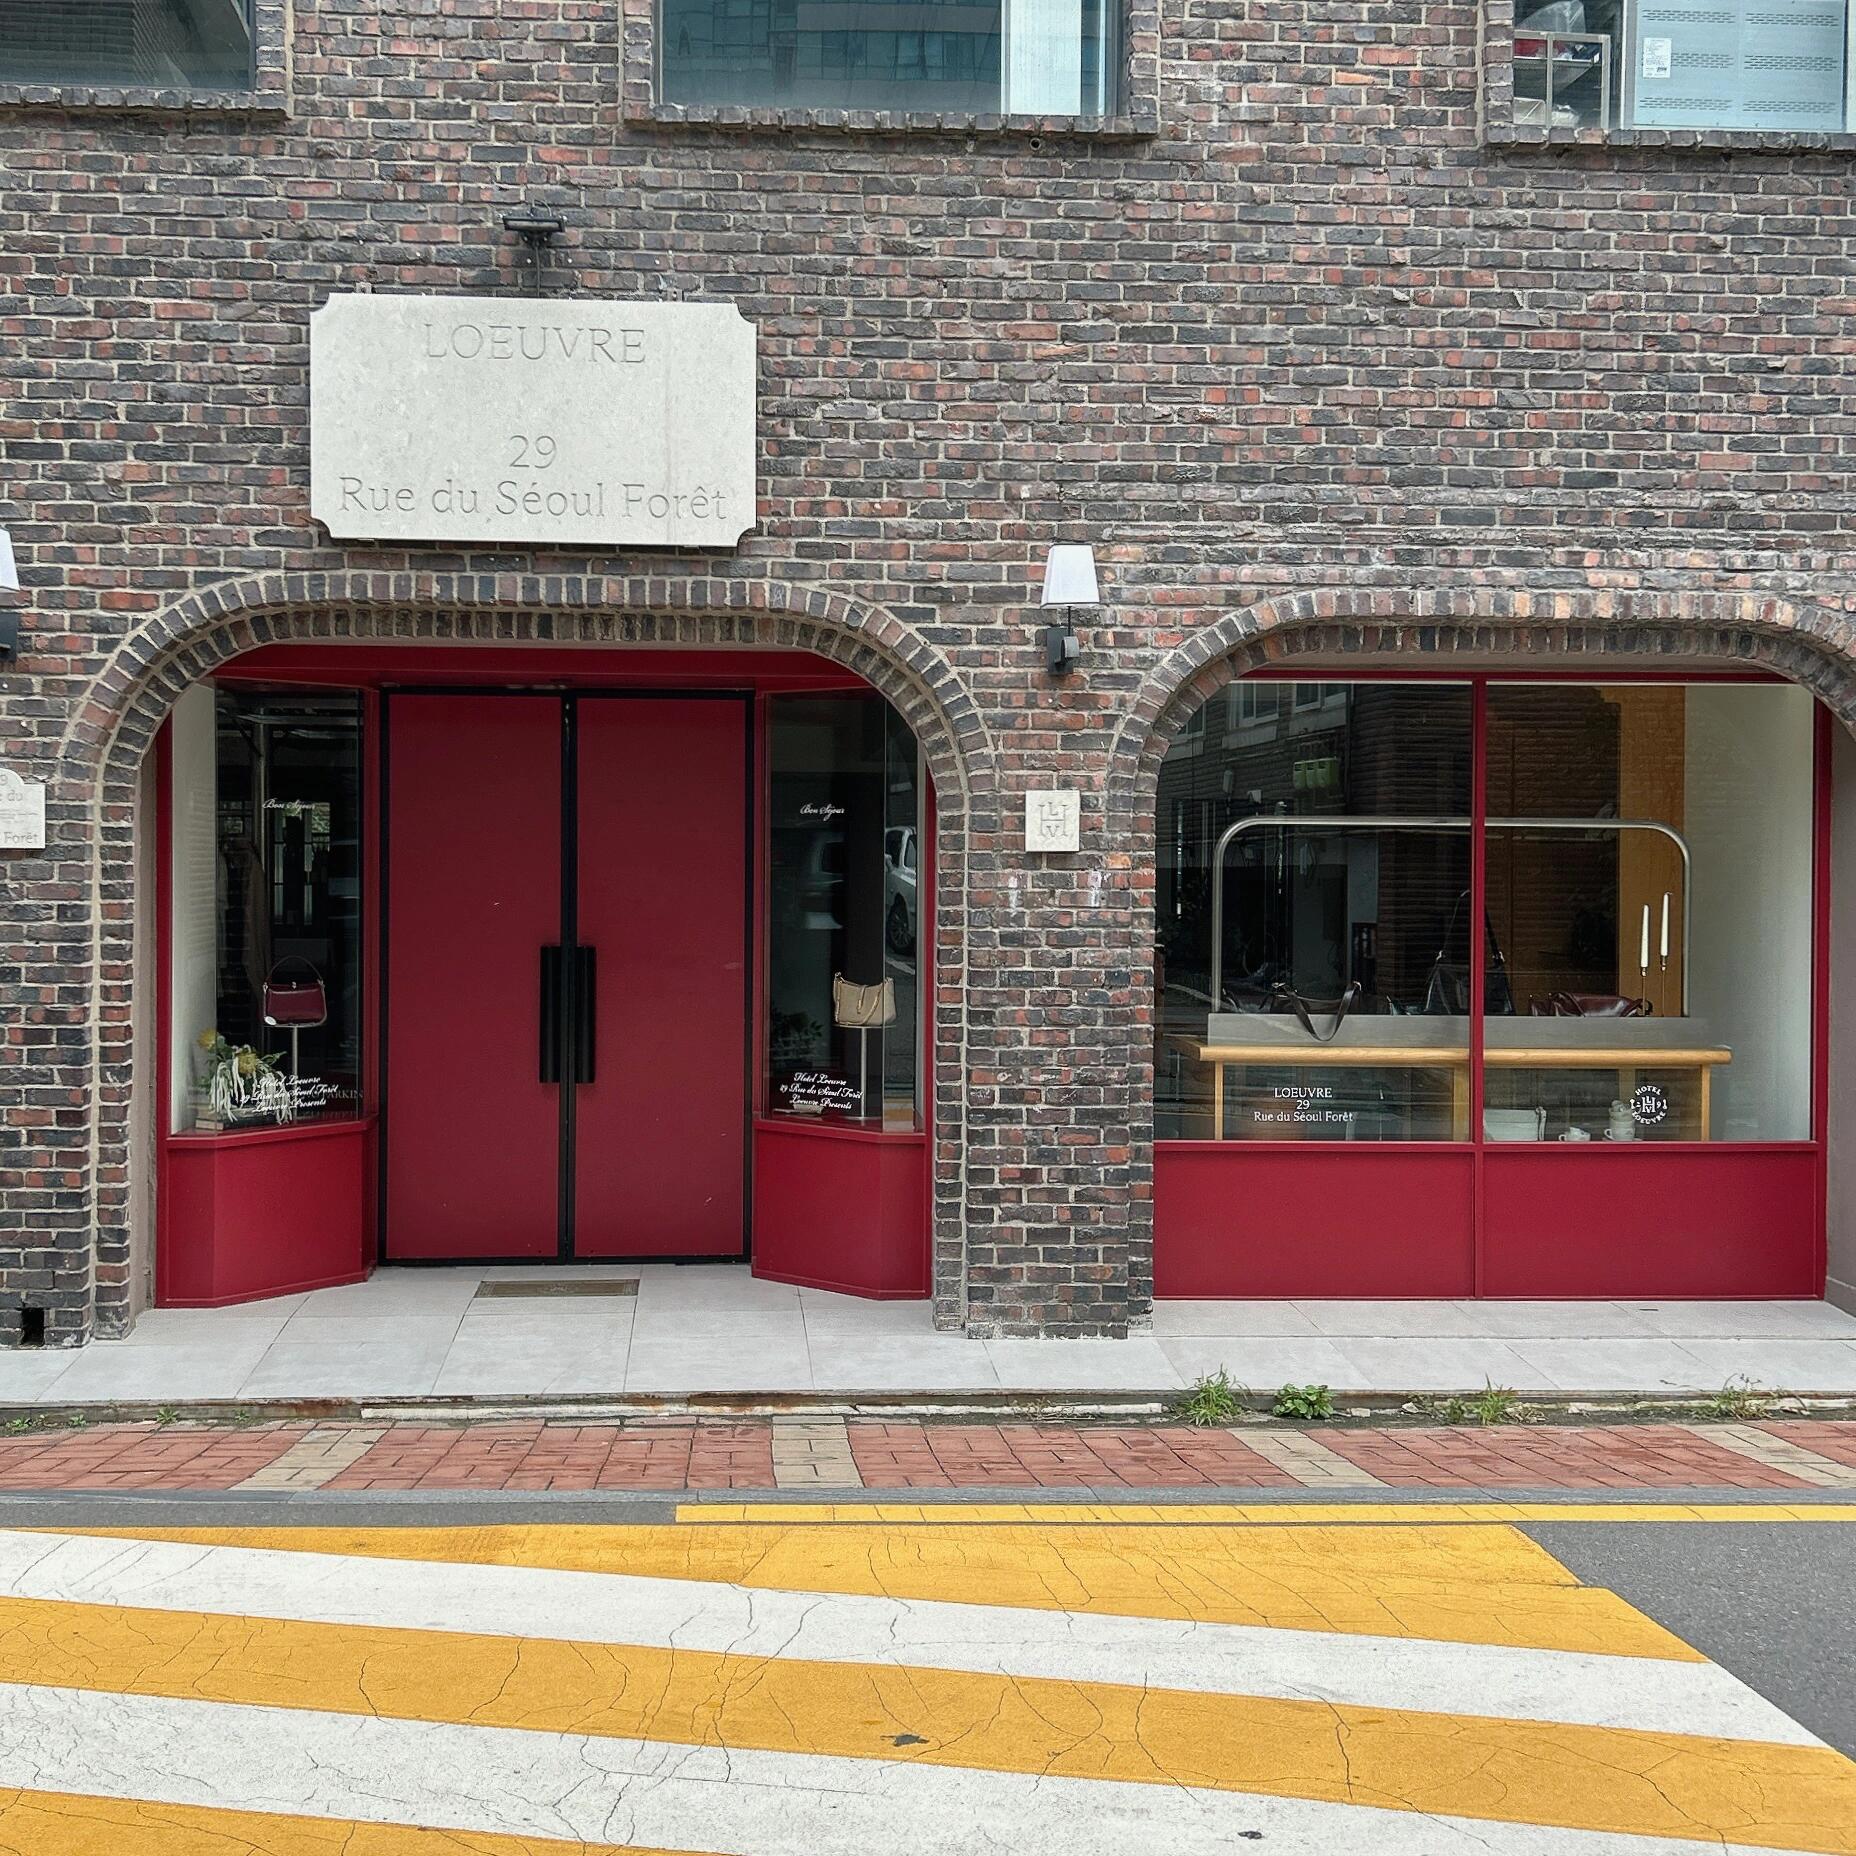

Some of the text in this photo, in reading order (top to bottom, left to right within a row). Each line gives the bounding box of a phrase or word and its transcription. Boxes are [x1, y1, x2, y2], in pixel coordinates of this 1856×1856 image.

[423, 323, 647, 364] LOEUVRE
[508, 434, 558, 470] 29
[338, 476, 728, 521] Rue du Séoul Forêt
[1273, 1087, 1333, 1098] LOEUVRE
[1634, 1085, 1662, 1095] HOTEL
[1296, 1099, 1311, 1110] 29
[1253, 1111, 1354, 1122] Rue du Séoul Forêt
